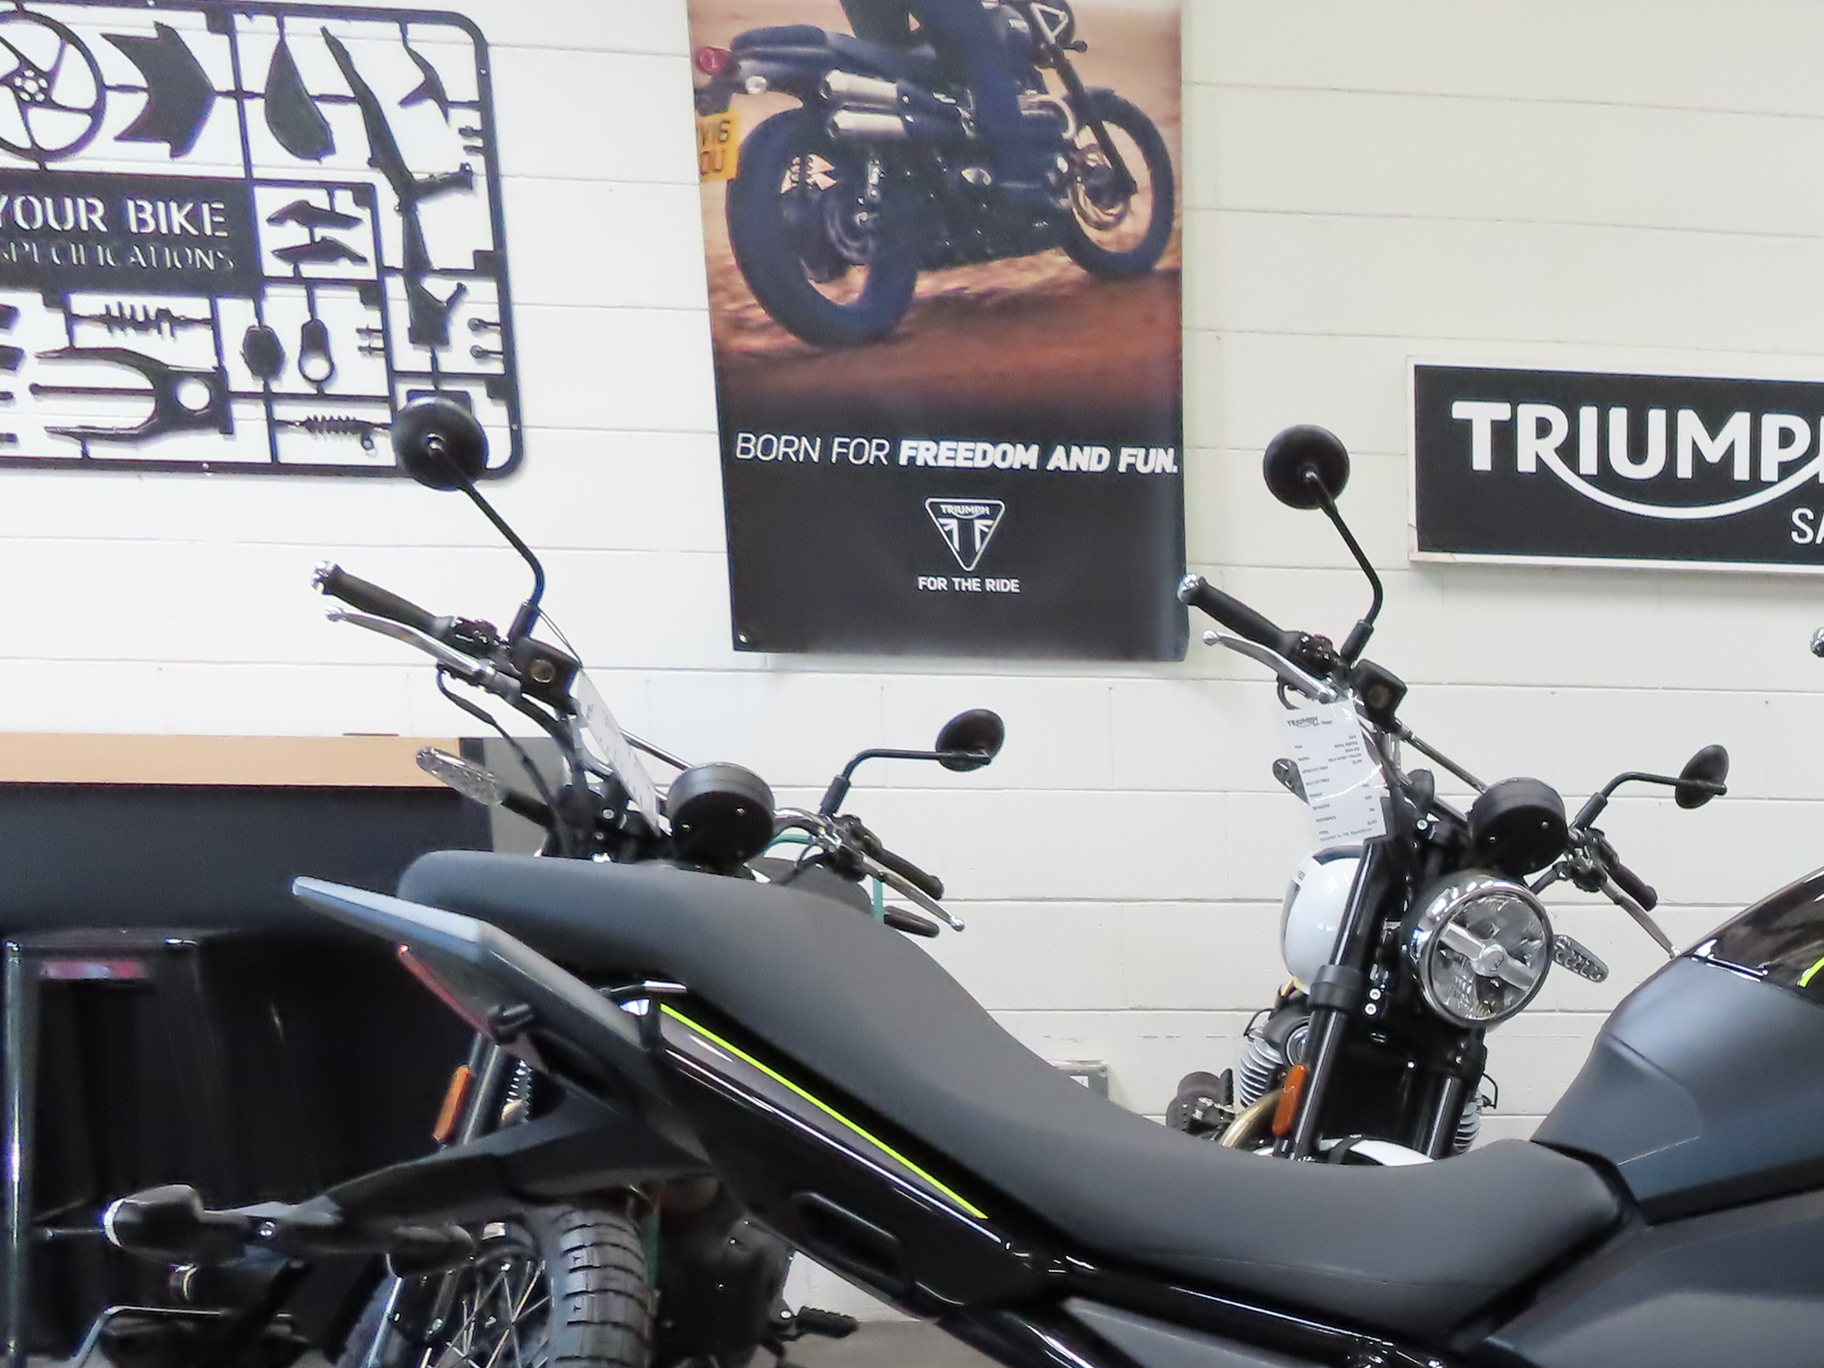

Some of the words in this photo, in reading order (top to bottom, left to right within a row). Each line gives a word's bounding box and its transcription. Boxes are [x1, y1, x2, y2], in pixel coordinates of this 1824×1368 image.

[126, 198, 229, 237] BIKE
[735, 432, 822, 463] BORN
[831, 437, 890, 466] FOR
[898, 439, 1040, 470] FREEDOM
[1045, 444, 1111, 472] AND
[1117, 446, 1178, 474] FUN.
[939, 504, 991, 519] TRIUMPH
[917, 576, 949, 591] FOR
[950, 577, 982, 592] THE
[984, 578, 1021, 593] RIDE
